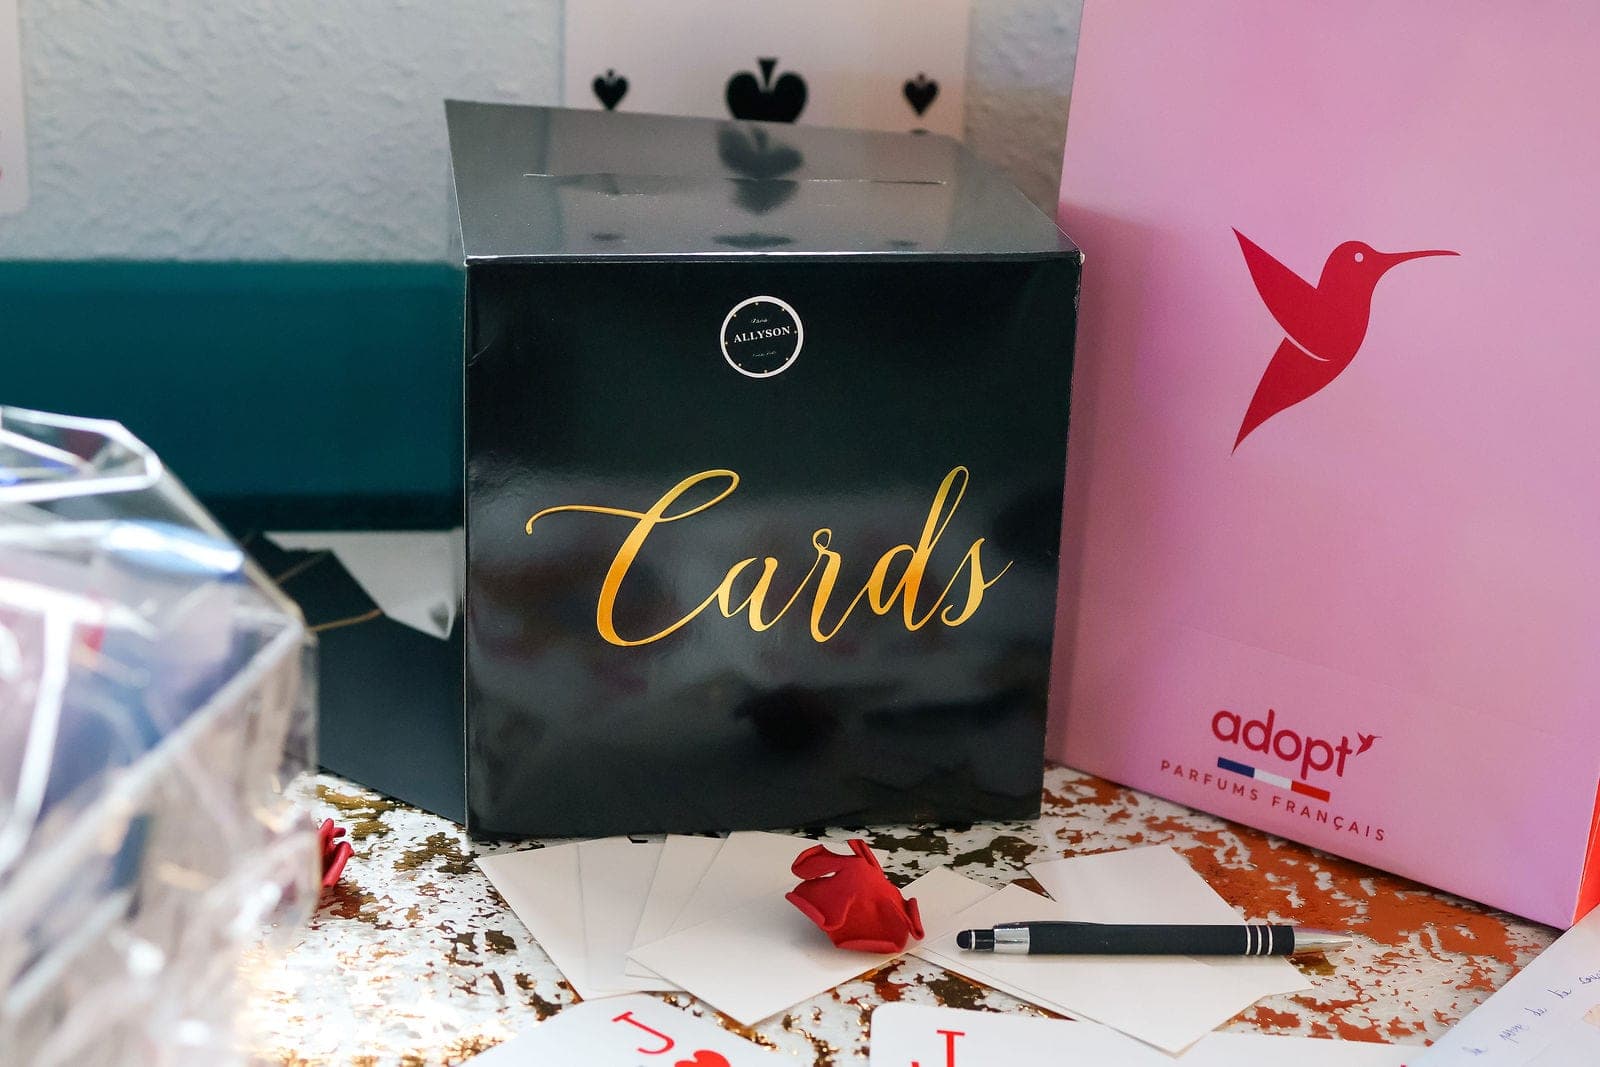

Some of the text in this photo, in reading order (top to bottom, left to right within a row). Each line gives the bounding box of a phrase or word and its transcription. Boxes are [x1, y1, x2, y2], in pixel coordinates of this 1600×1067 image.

[733, 325, 791, 343] ALLYSON
[525, 465, 1013, 646] Cards
[1211, 708, 1353, 780] adopt
[1160, 759, 1385, 841] PARFUMS FRANÇAIS
[611, 1011, 675, 1054] J
[911, 1029, 965, 1067] J
